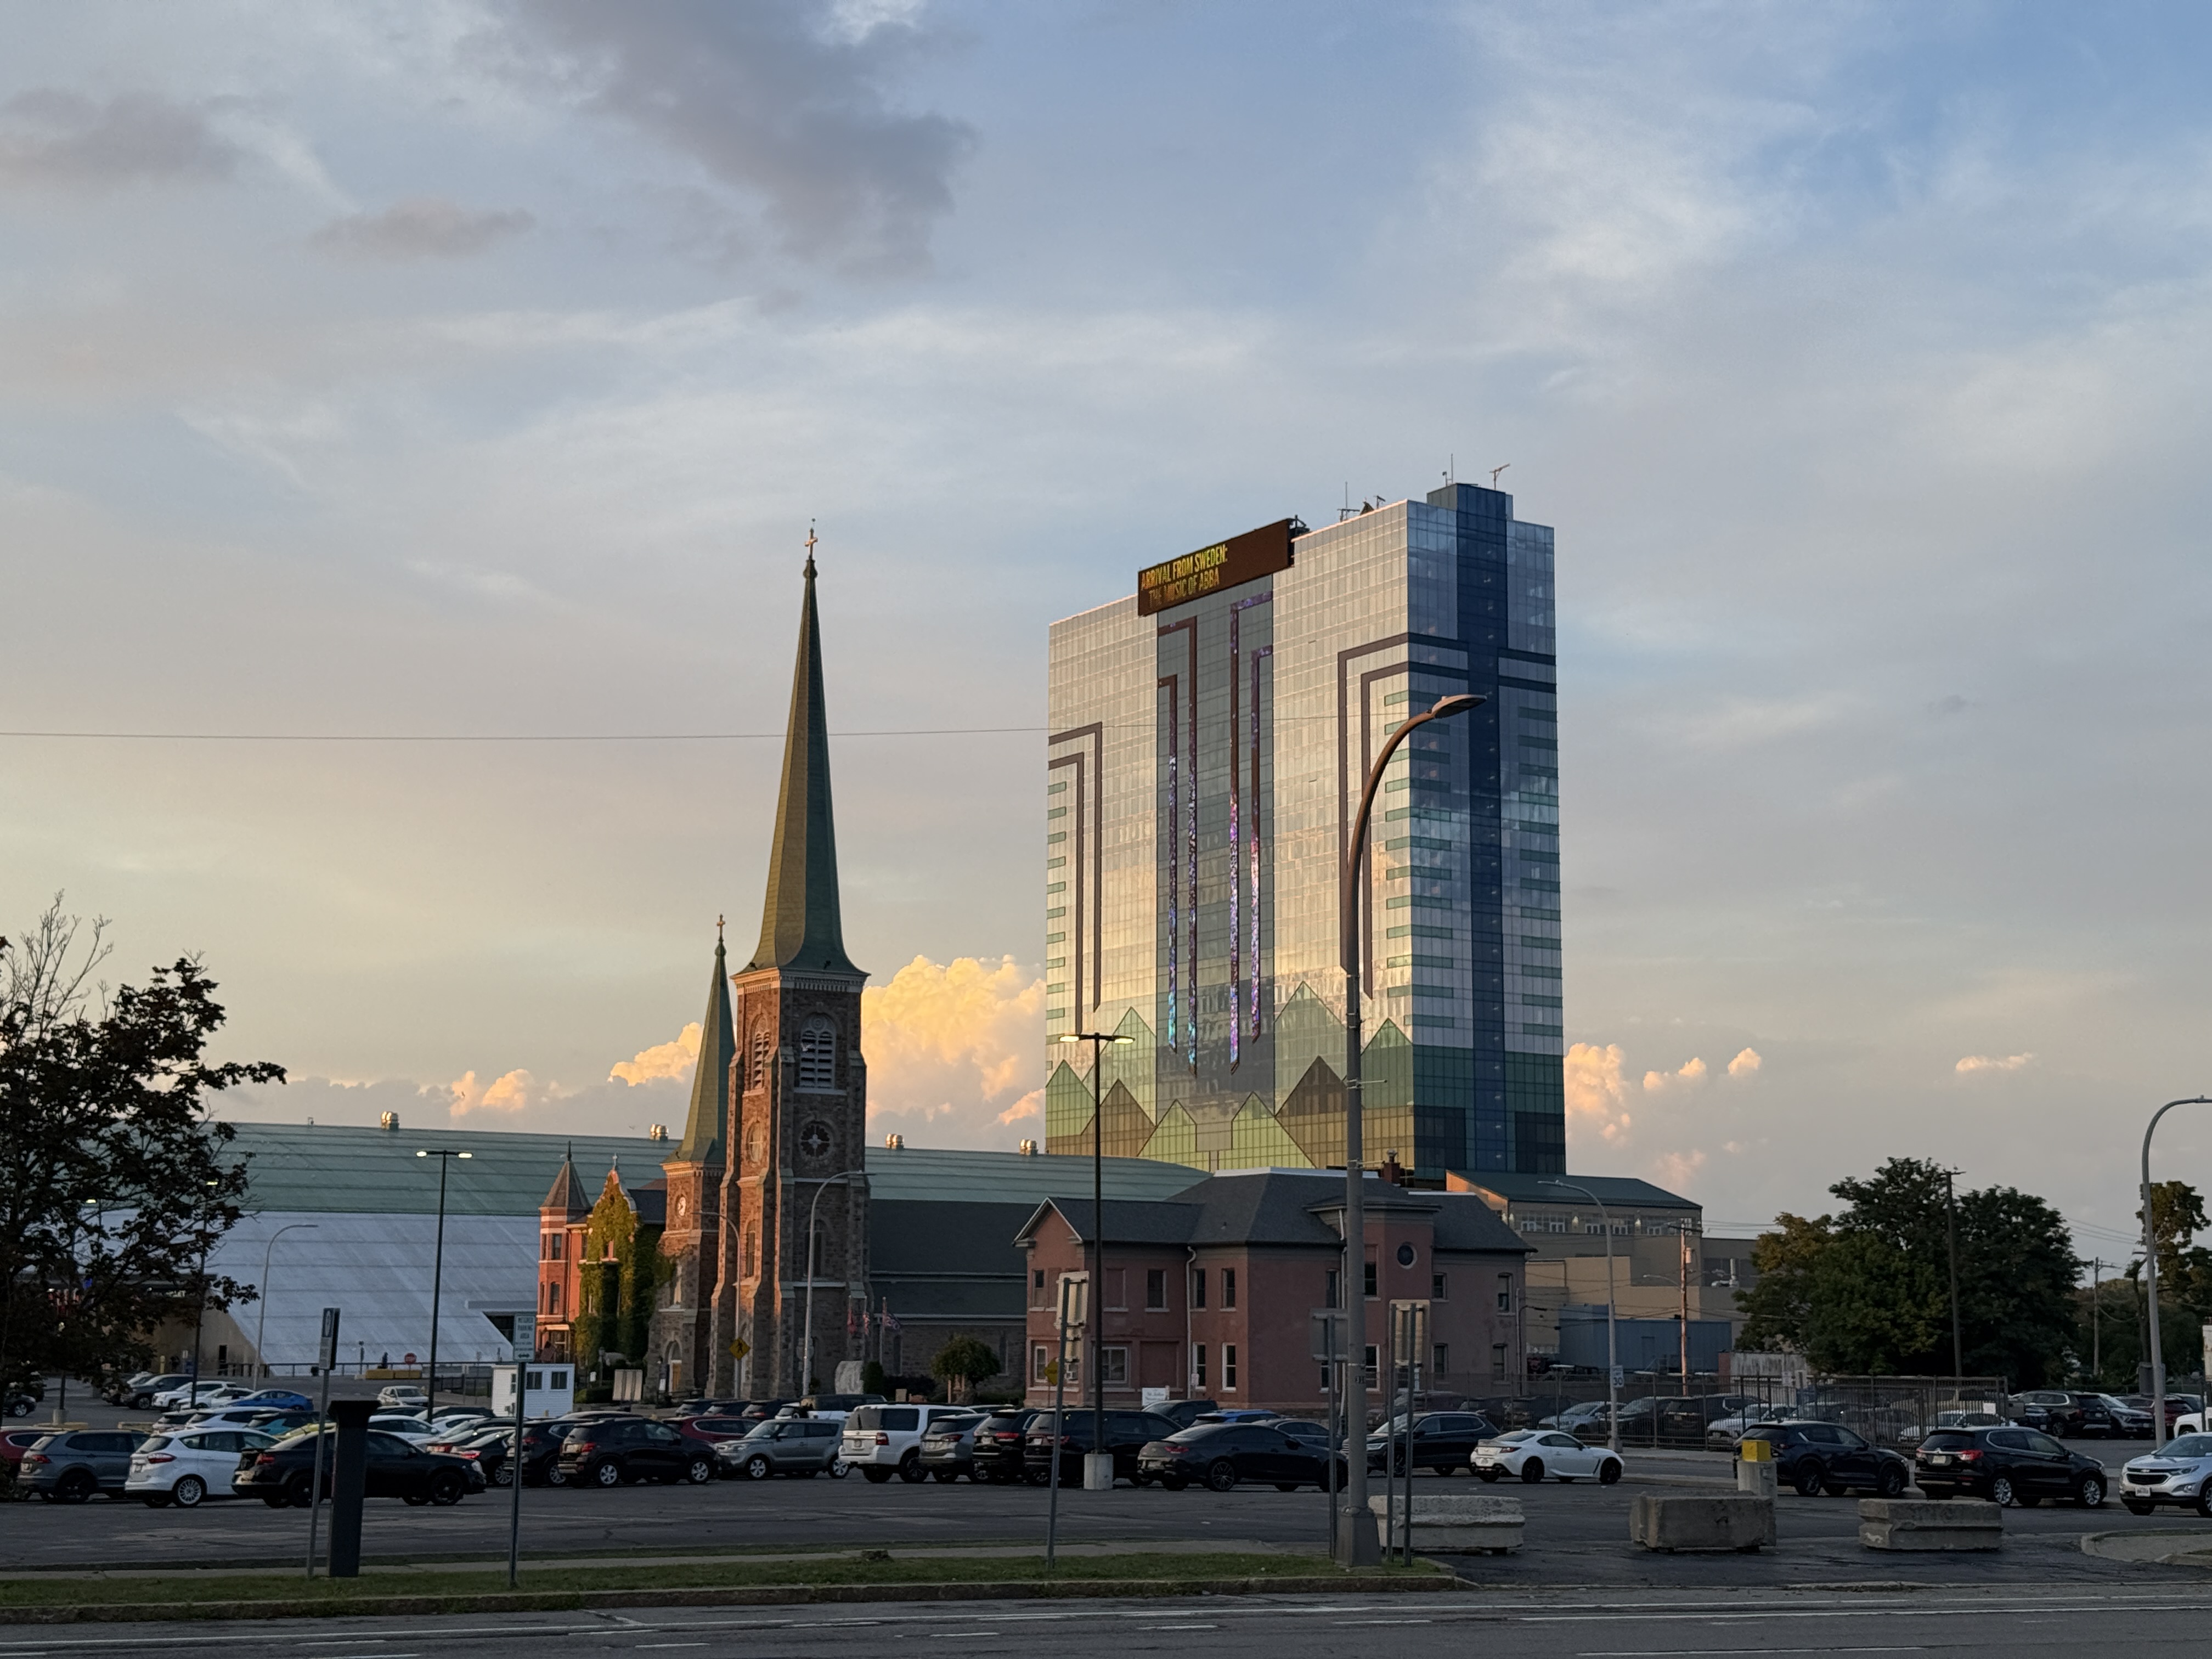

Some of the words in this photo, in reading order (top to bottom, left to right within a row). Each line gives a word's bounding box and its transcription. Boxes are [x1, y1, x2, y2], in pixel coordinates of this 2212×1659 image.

[1141, 563, 1171, 591] ARRIVAL
[1172, 555, 1193, 580] FROM
[1194, 544, 1228, 572] SWEDEN:
[1163, 579, 1187, 602] MUSIC
[1188, 574, 1198, 595] OF
[1198, 567, 1220, 591] ABBA
[1613, 1377, 1623, 1386] 30
